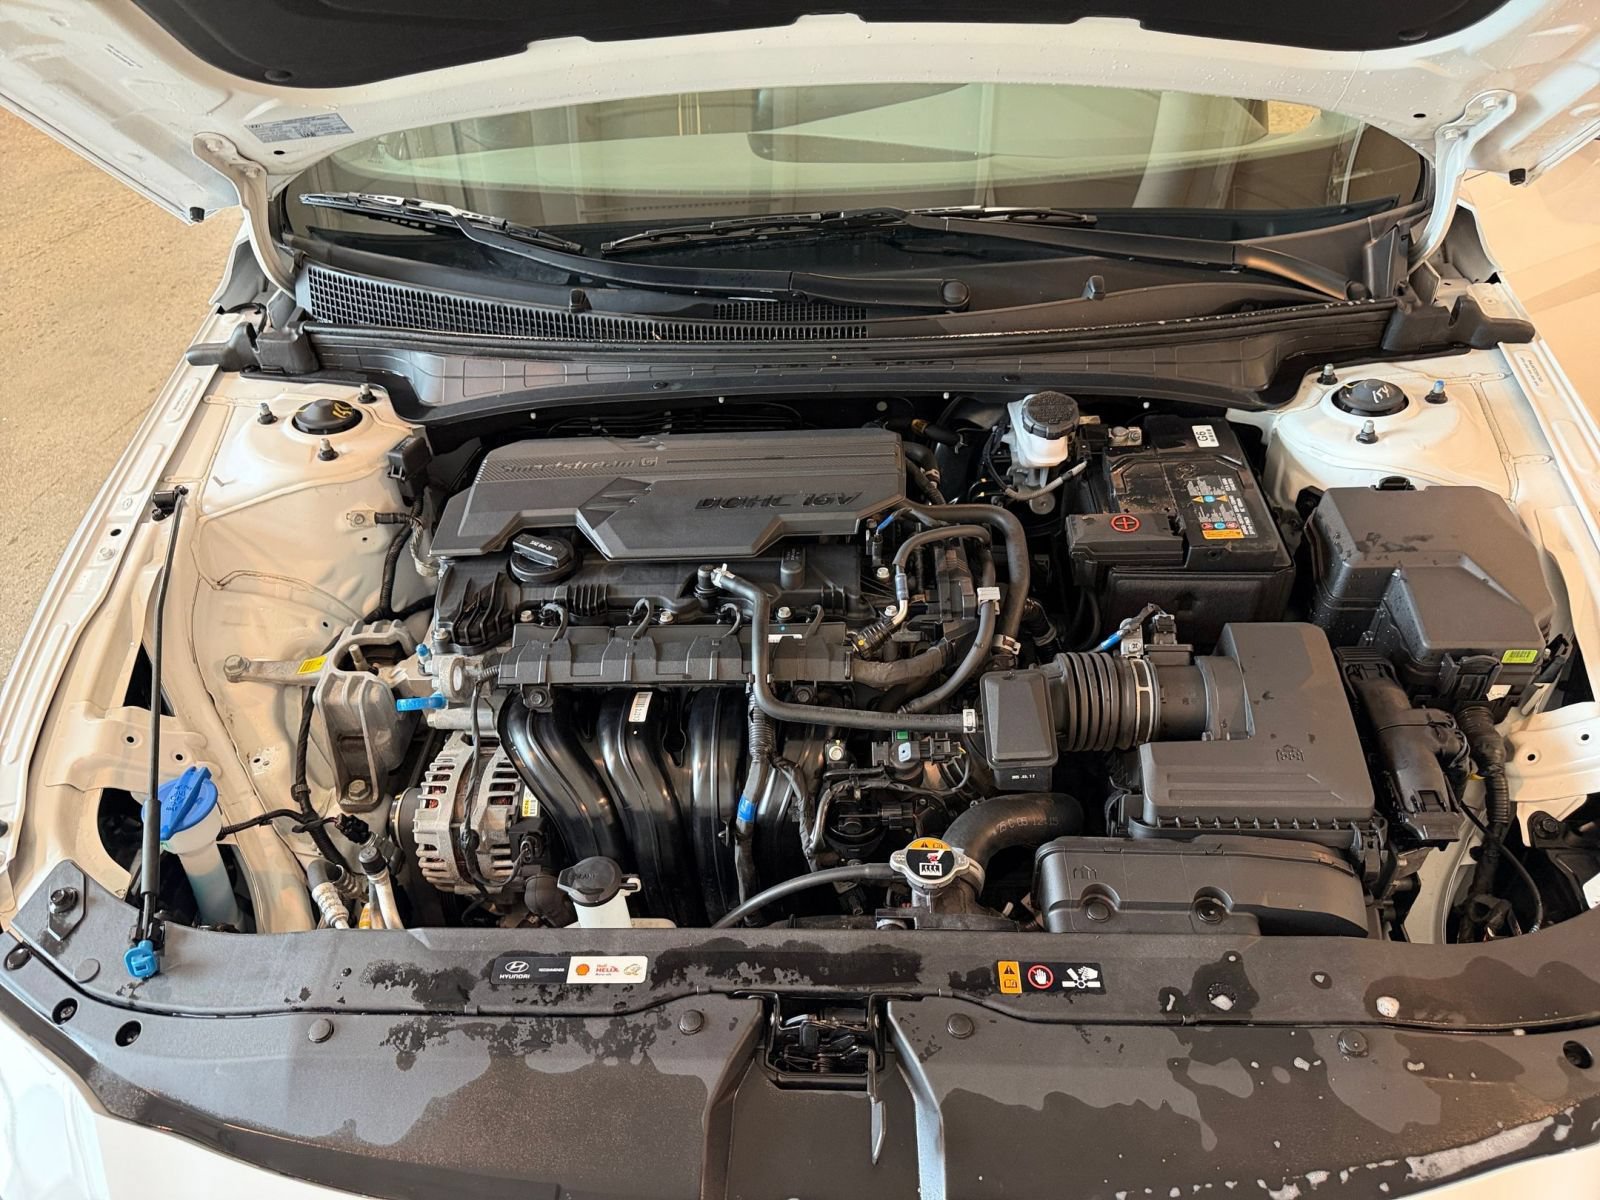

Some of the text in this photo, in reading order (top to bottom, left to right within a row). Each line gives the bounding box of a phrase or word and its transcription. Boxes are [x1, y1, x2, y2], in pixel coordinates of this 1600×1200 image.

[502, 459, 636, 473] Smartstream
[695, 491, 864, 510] DOHC 16V
